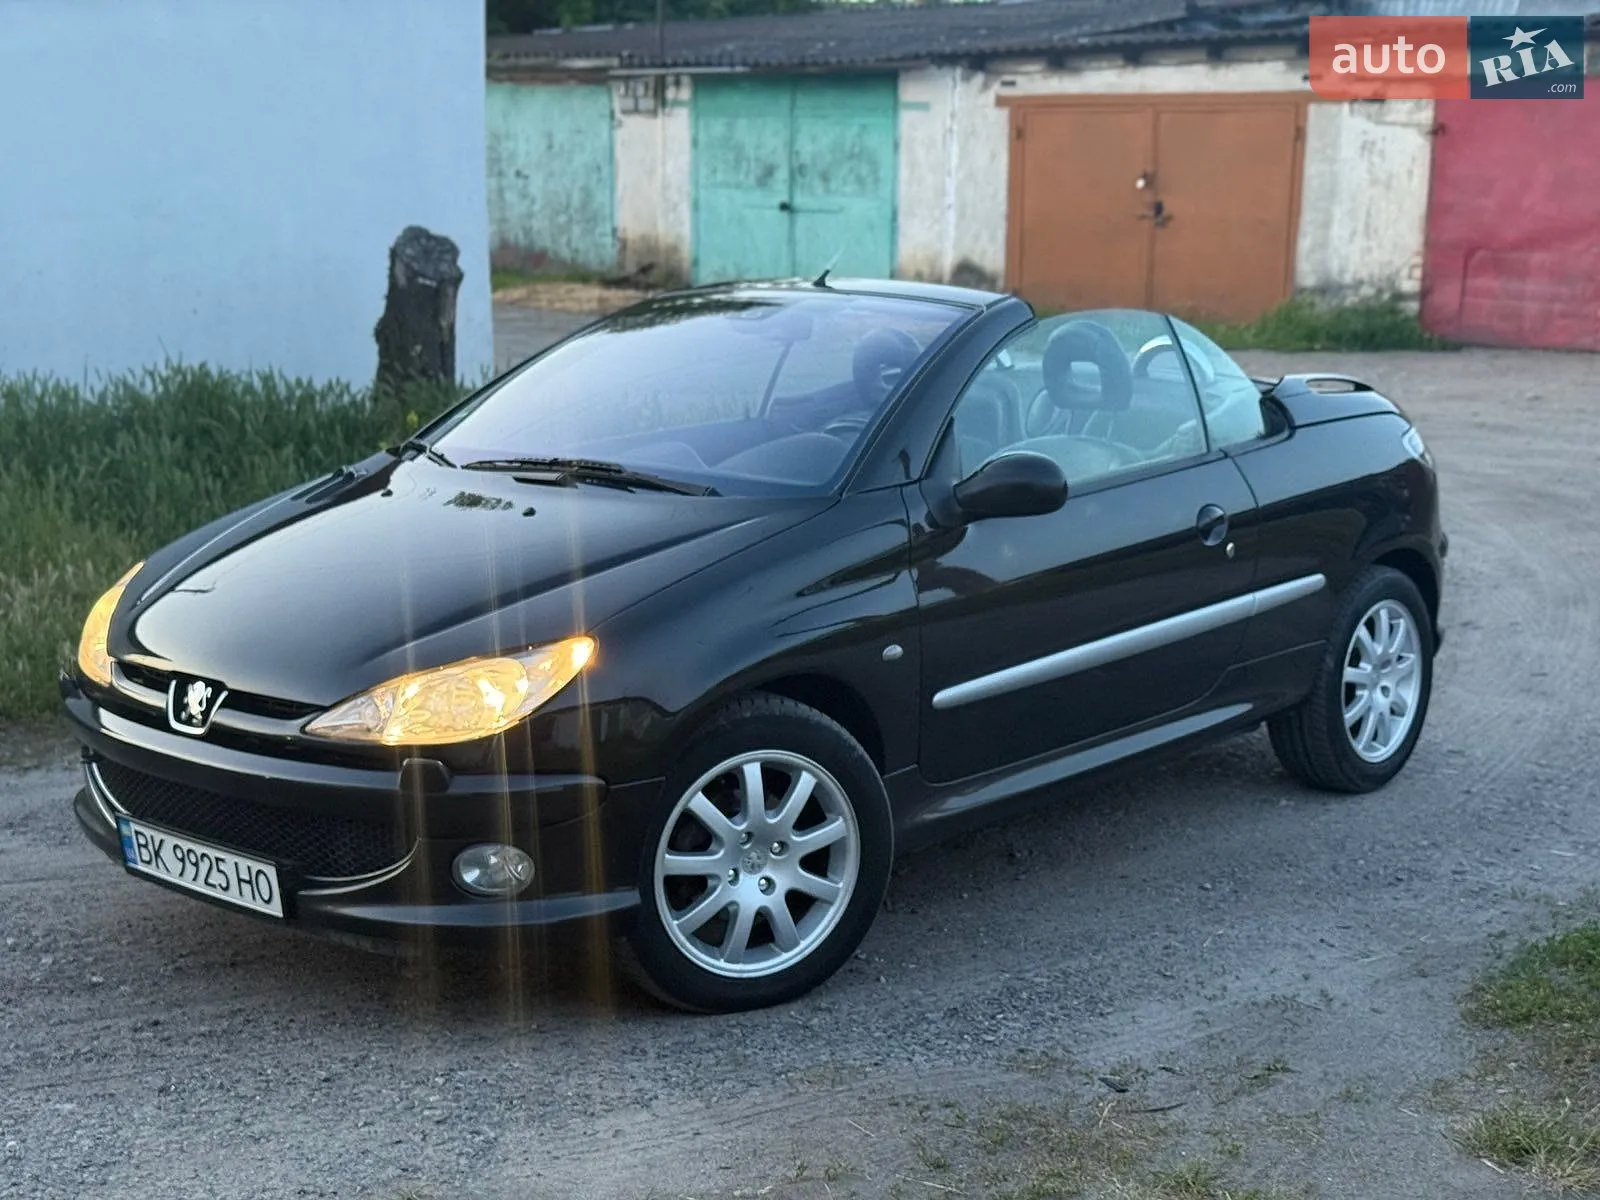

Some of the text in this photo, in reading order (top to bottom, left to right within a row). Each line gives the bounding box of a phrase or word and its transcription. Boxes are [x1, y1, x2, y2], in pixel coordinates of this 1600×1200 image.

[134, 829, 273, 905] BK 9925 HO
